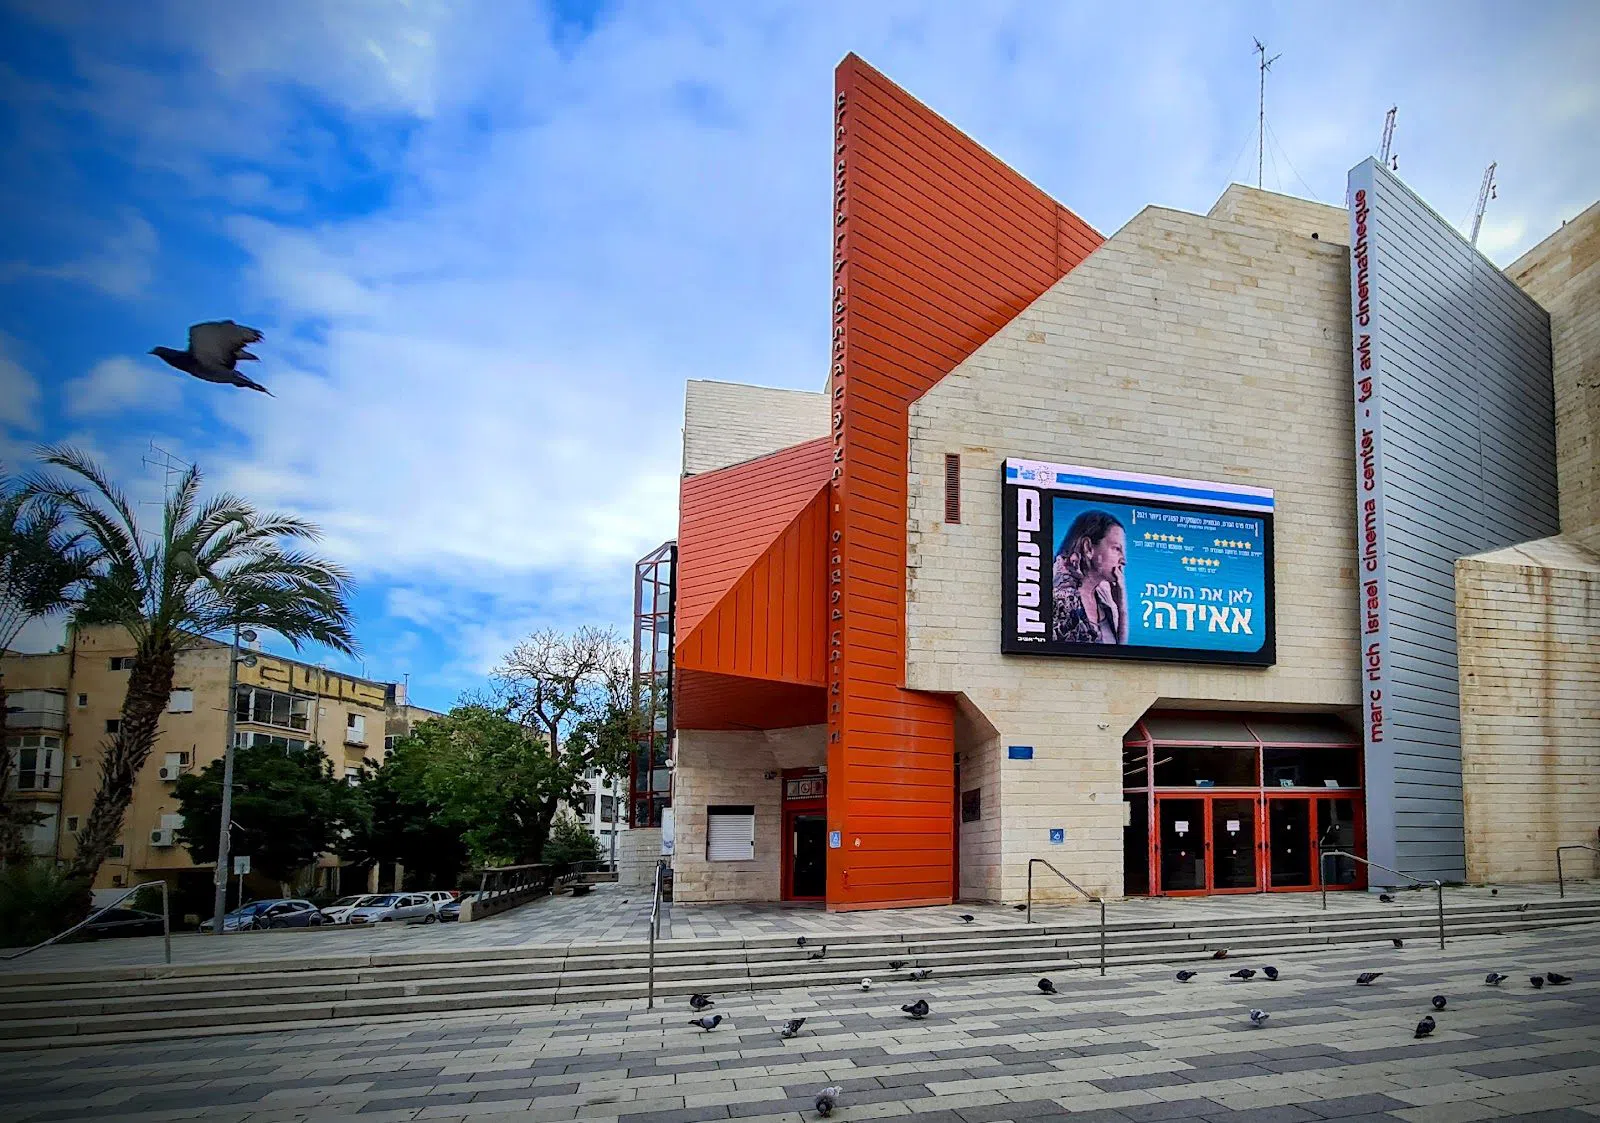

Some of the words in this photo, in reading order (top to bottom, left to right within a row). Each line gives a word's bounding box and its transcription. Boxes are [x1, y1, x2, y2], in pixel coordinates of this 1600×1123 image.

[836, 91, 847, 155] מרכז
[835, 159, 848, 227] מארק
[1354, 189, 1370, 327] cinematheque
[832, 286, 846, 377] לקולנוע
[1357, 335, 1371, 371] aviv
[1358, 376, 1372, 403] tel
[831, 386, 844, 488] הישראלי
[1360, 428, 1375, 491] center
[1017, 488, 1046, 633] סינמטק
[1363, 499, 1378, 572] cinema
[831, 530, 843, 620] סינמטק
[1140, 581, 1194, 598] הולכת,
[1199, 587, 1223, 602] את
[1228, 587, 1253, 605] לאן
[1141, 599, 1253, 635] אאידה?
[1364, 579, 1378, 635] israel
[1366, 642, 1380, 681] rich
[1370, 688, 1382, 743] marc
